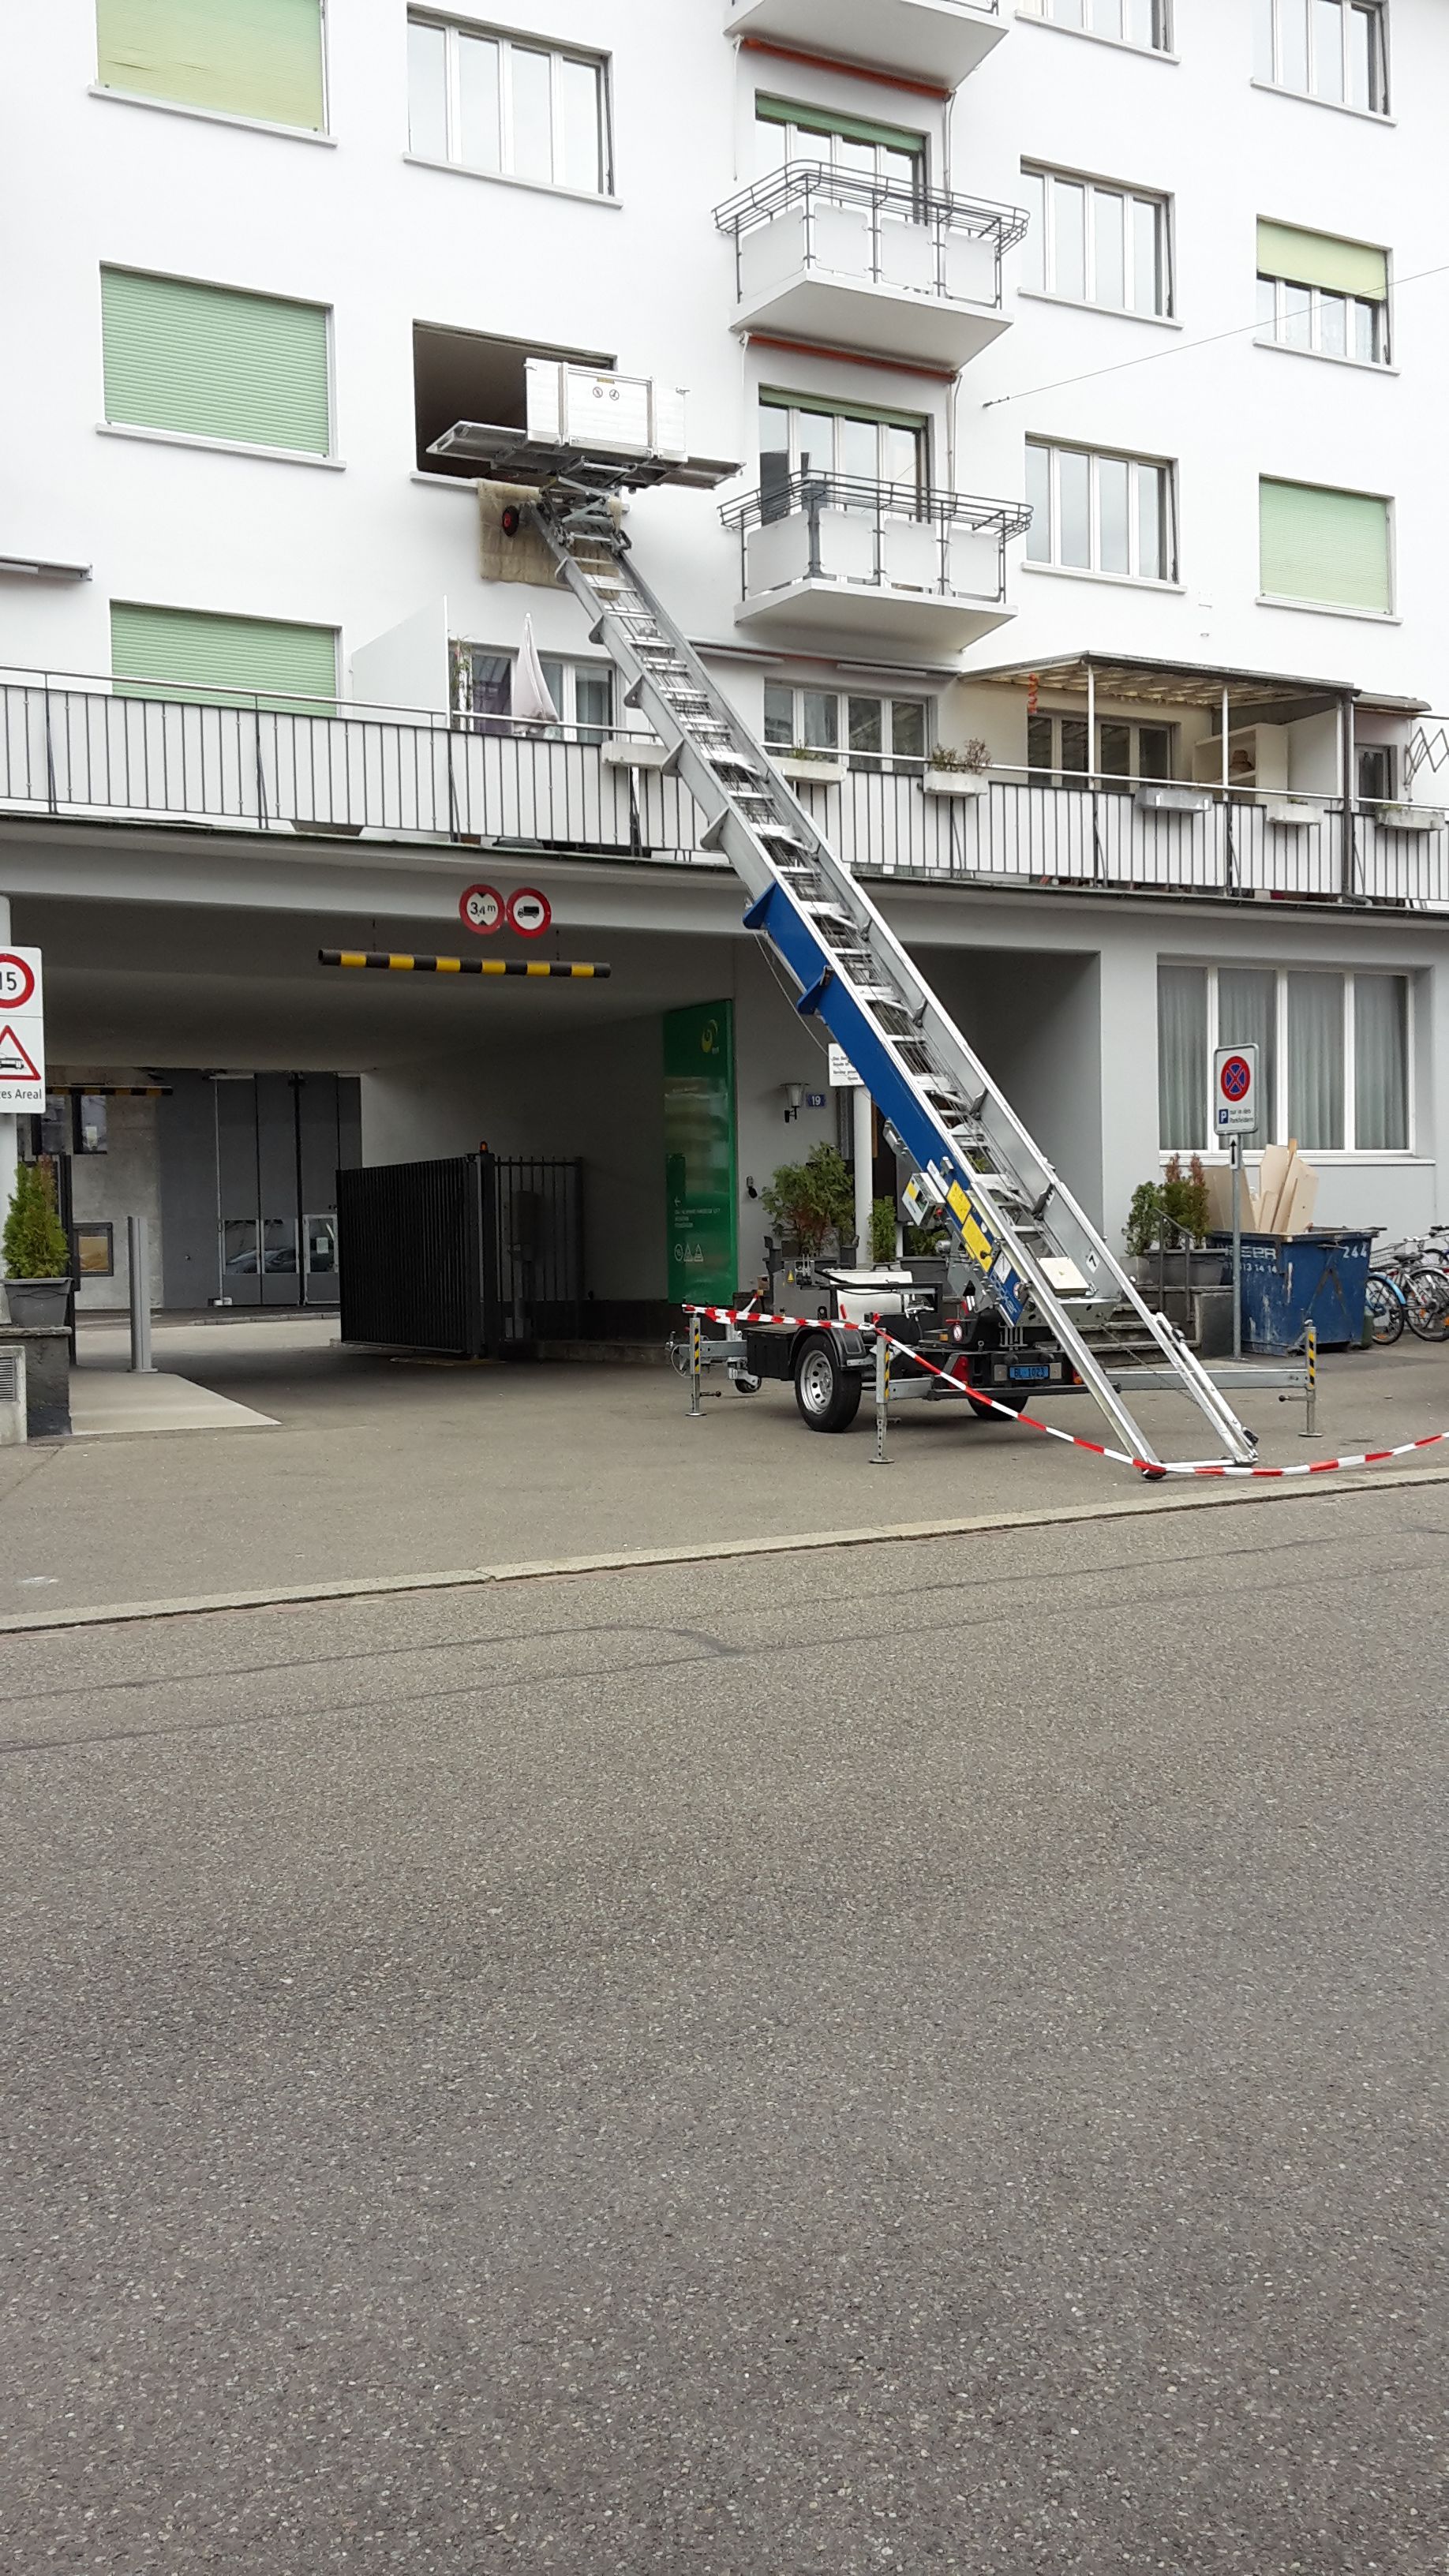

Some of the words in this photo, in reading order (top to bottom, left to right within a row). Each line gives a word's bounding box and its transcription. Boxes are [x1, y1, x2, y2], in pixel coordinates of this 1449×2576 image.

[15, 1088, 42, 1099] Areal
[811, 1095, 822, 1106] 19
[1342, 1242, 1367, 1259] 244
